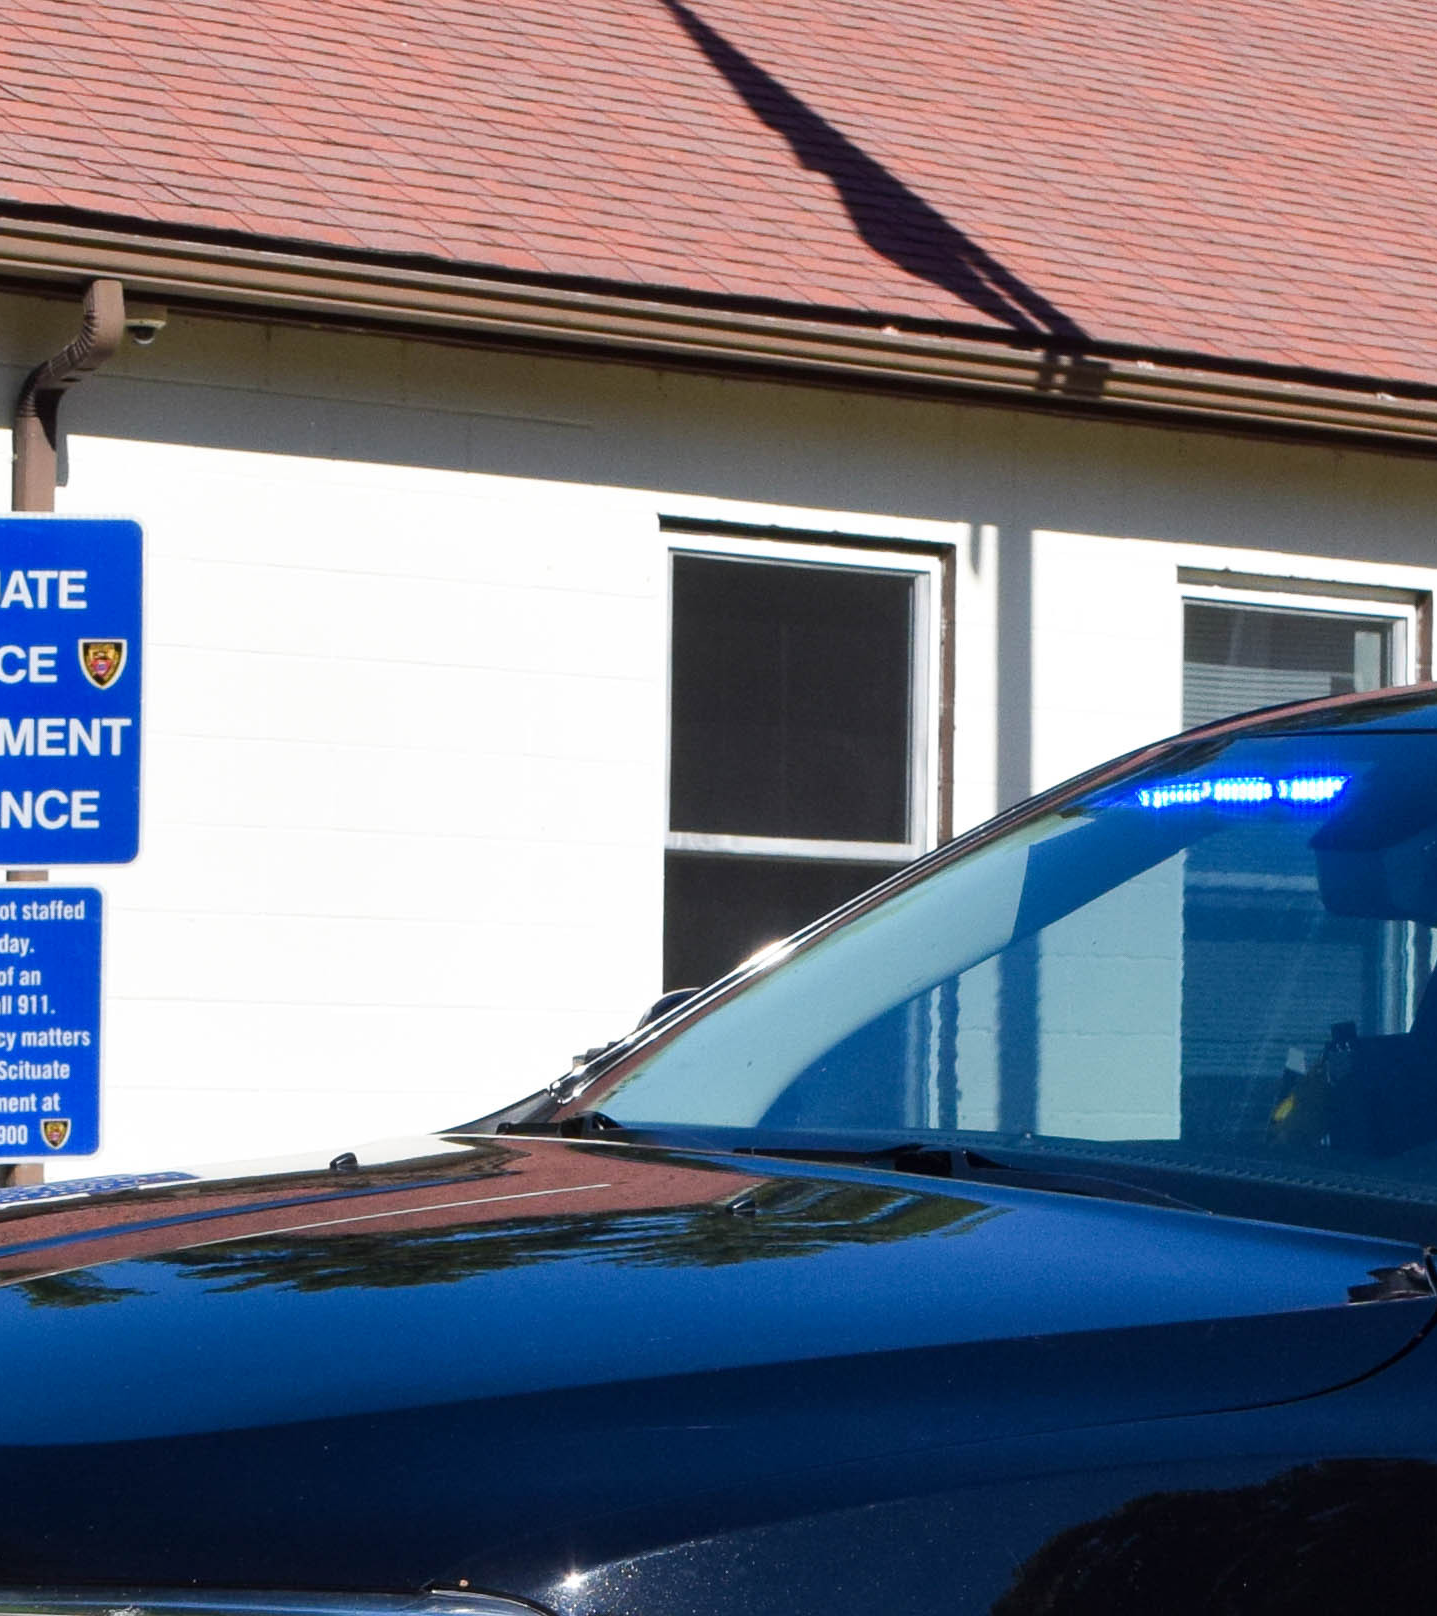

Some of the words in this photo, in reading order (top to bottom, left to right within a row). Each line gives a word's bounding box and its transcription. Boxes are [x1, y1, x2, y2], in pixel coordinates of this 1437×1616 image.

[22, 901, 85, 921] staffed
[19, 970, 41, 986] an
[18, 995, 55, 1015] 911.
[21, 1028, 91, 1047] matters
[42, 1093, 61, 1112] at
